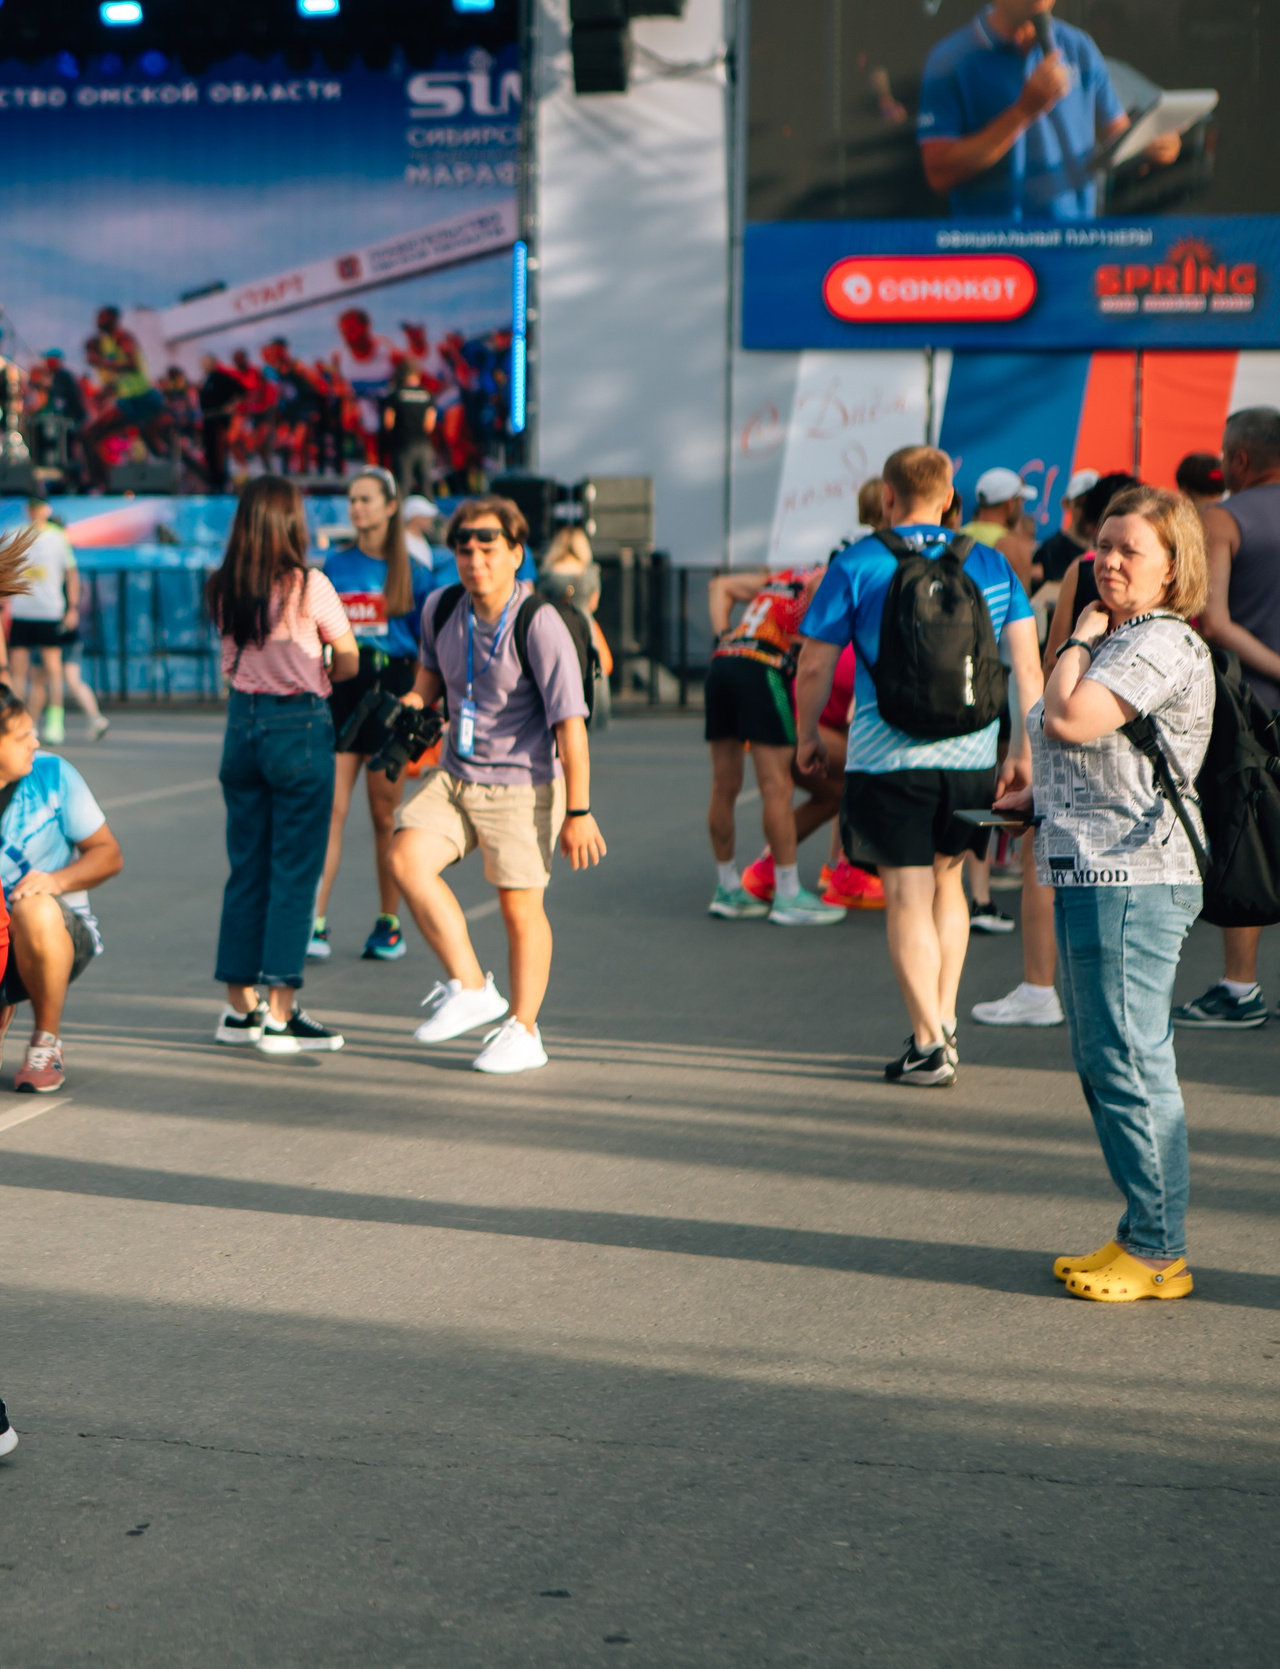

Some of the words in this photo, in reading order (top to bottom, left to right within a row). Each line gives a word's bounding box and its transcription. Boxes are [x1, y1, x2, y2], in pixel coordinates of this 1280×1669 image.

[77, 82, 198, 107] ОМСКОЙ
[209, 80, 341, 103] ОБЛАСТИ
[1096, 254, 1257, 297] SPRING
[1072, 868, 1129, 884] MOOD
